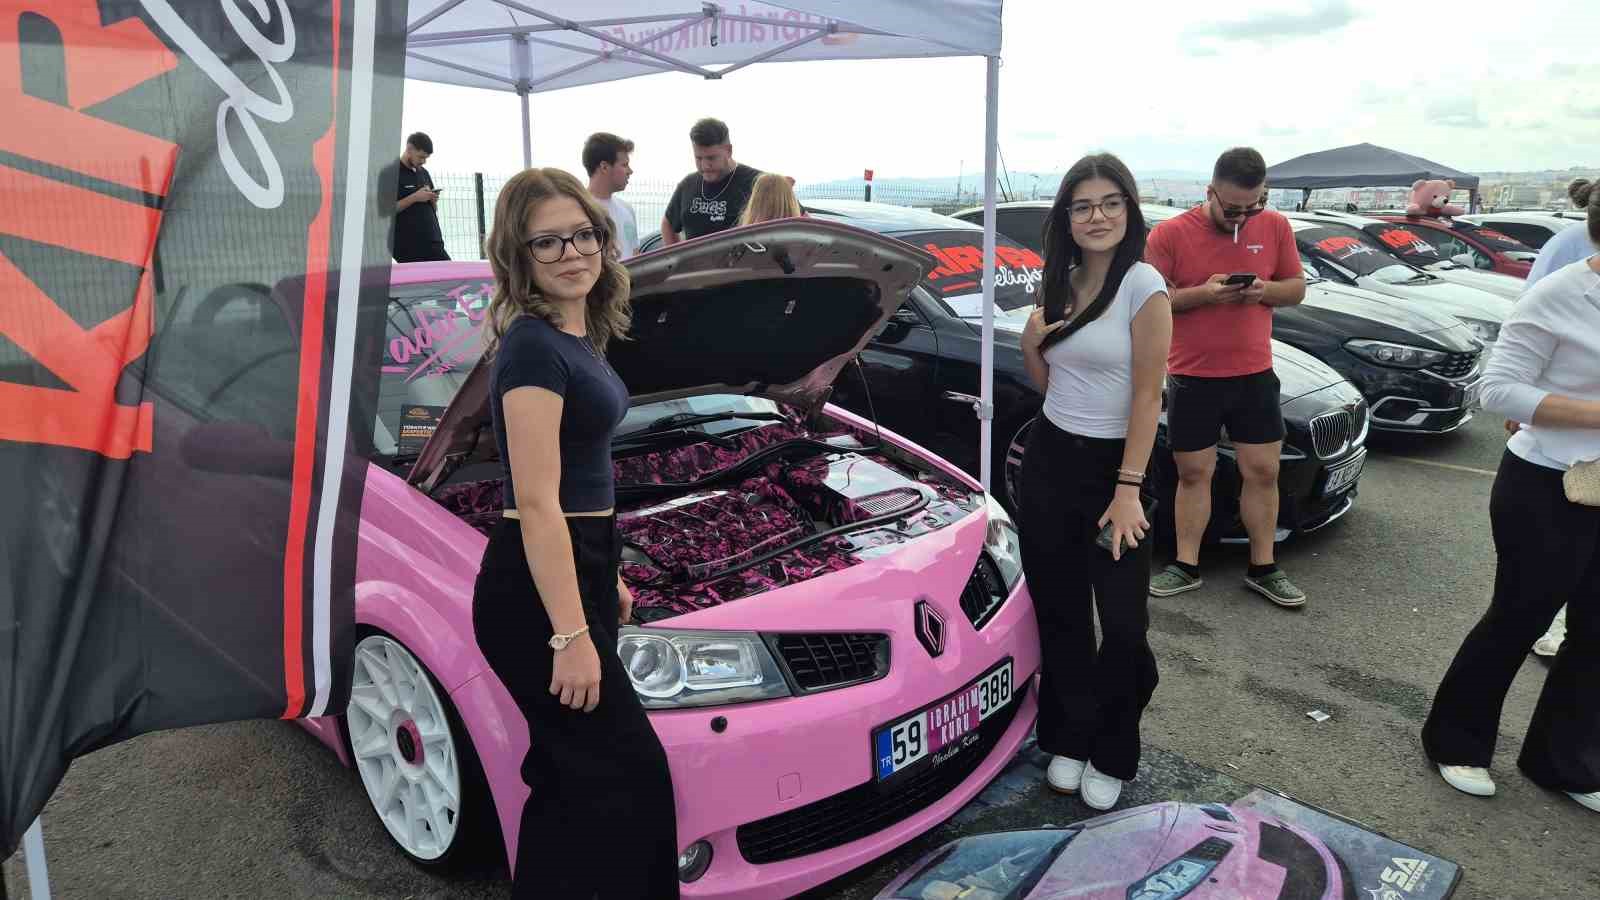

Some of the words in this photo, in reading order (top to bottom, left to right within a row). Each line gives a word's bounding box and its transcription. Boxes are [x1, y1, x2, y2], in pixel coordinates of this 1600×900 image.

[893, 720, 921, 765] 59
[980, 668, 1010, 715] 388
[941, 713, 969, 745] KURU
[880, 757, 892, 769] TR
